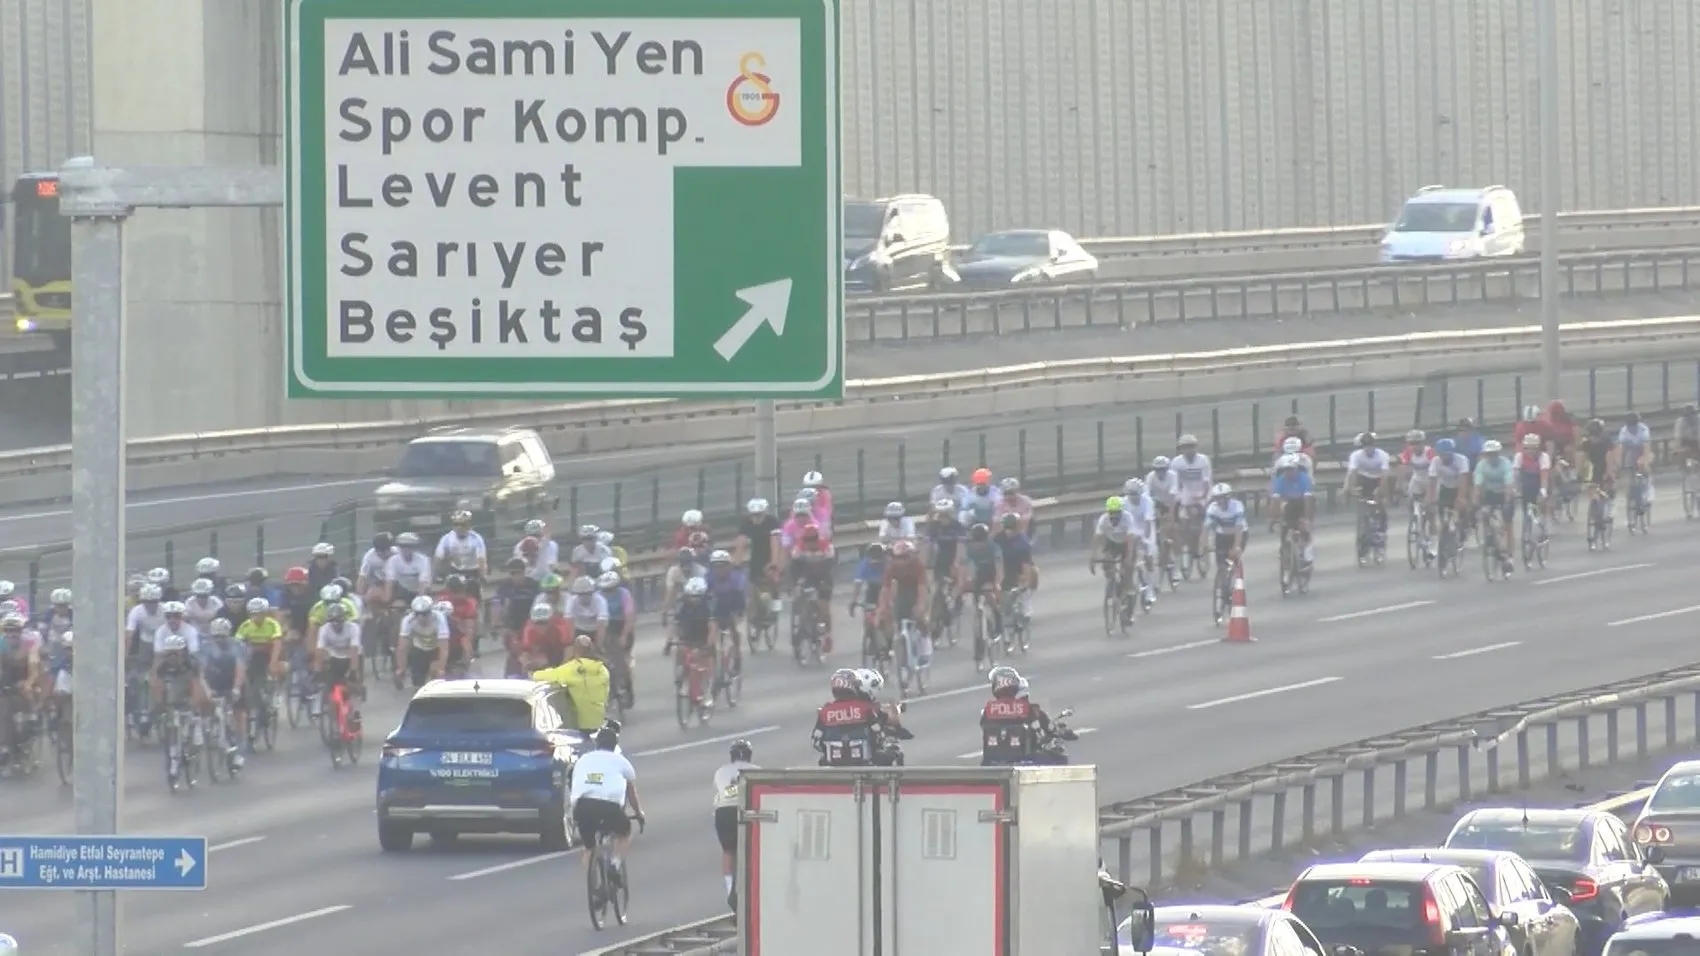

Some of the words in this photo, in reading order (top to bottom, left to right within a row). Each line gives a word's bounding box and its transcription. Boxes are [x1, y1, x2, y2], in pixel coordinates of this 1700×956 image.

[338, 29, 410, 76] Ali
[427, 29, 575, 76] Sami
[590, 31, 704, 76] Yen
[338, 97, 486, 156] Spor
[514, 99, 705, 156] Komp.
[338, 163, 582, 208] Levent
[340, 232, 604, 289] Sarıyer
[339, 298, 648, 351] Beşiktaş
[30, 845, 77, 863] Hamidiye
[107, 845, 165, 863] Seyrantepe
[63, 869, 75, 880] ve
[105, 866, 156, 880] Hastanesi
